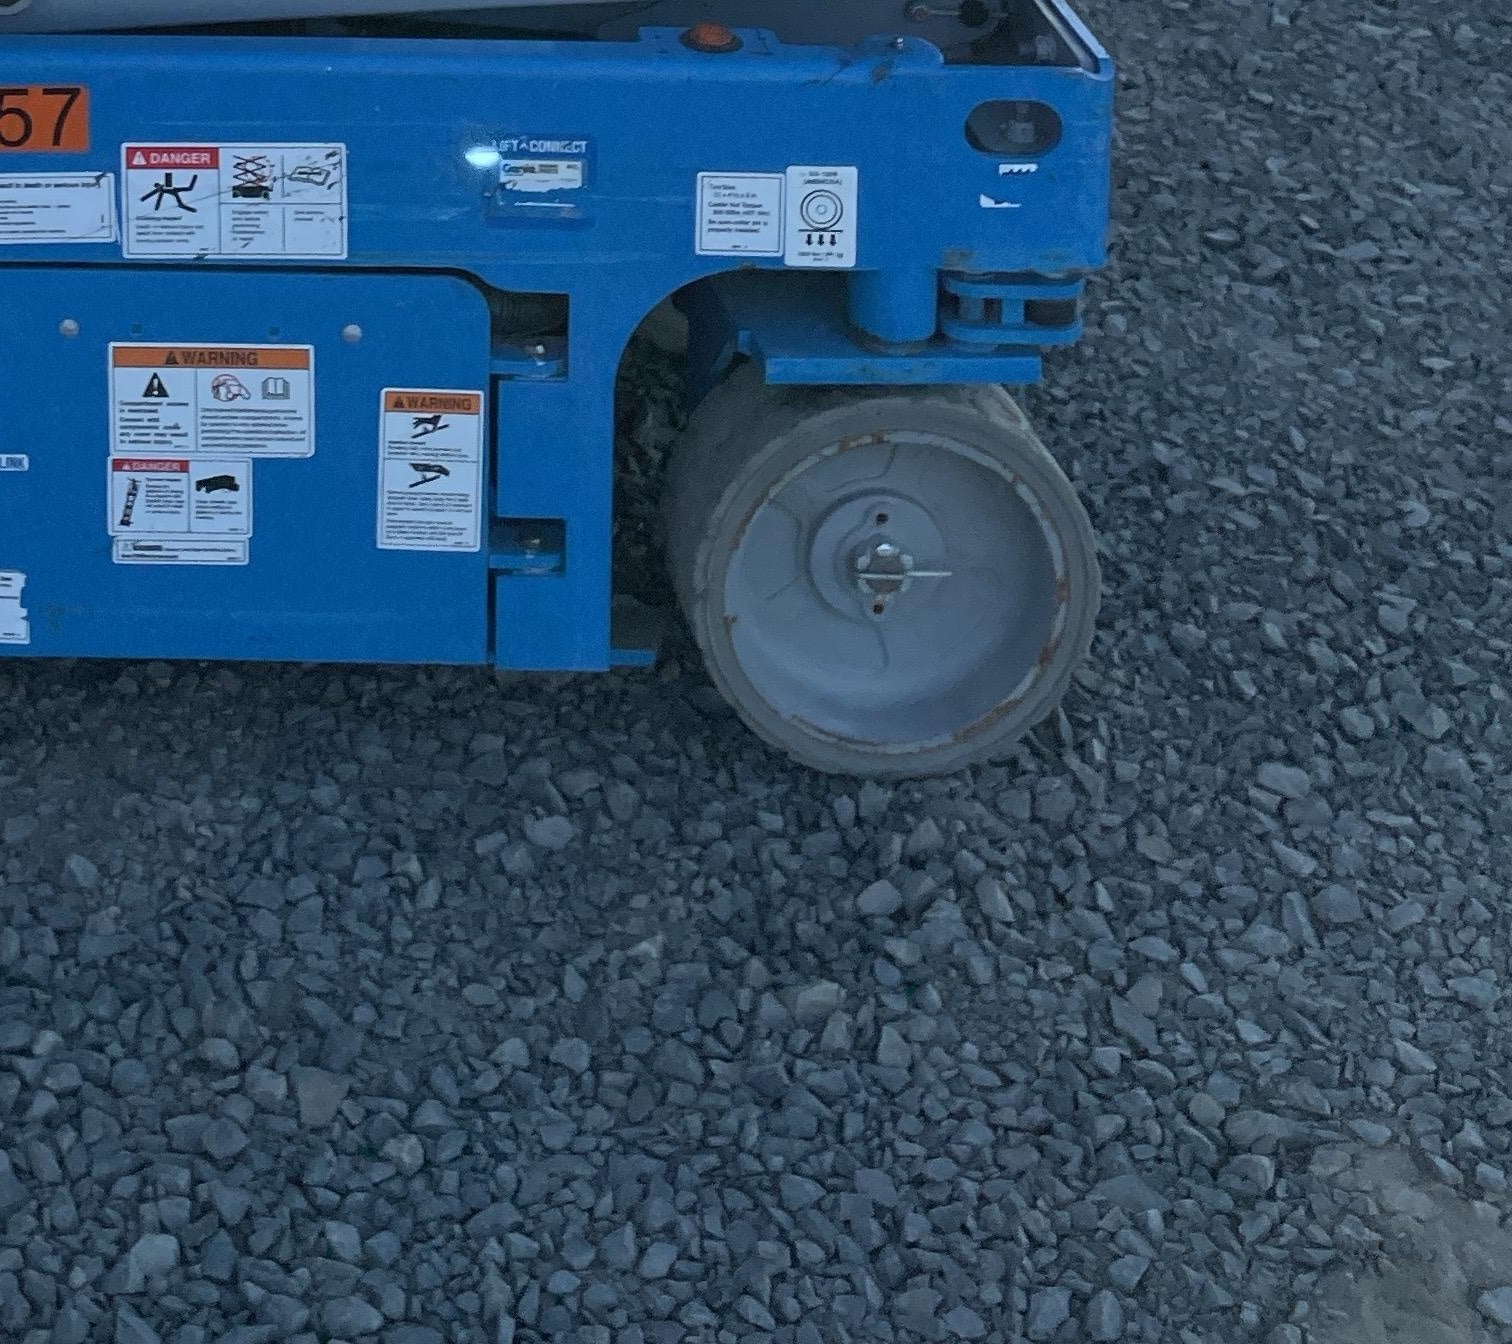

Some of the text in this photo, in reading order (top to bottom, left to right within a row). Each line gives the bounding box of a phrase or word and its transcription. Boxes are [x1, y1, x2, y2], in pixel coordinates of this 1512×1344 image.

[529, 139, 587, 153] CONNECT
[150, 152, 211, 164] DANGER
[182, 351, 259, 366] WARNING
[407, 396, 472, 411] WARNING
